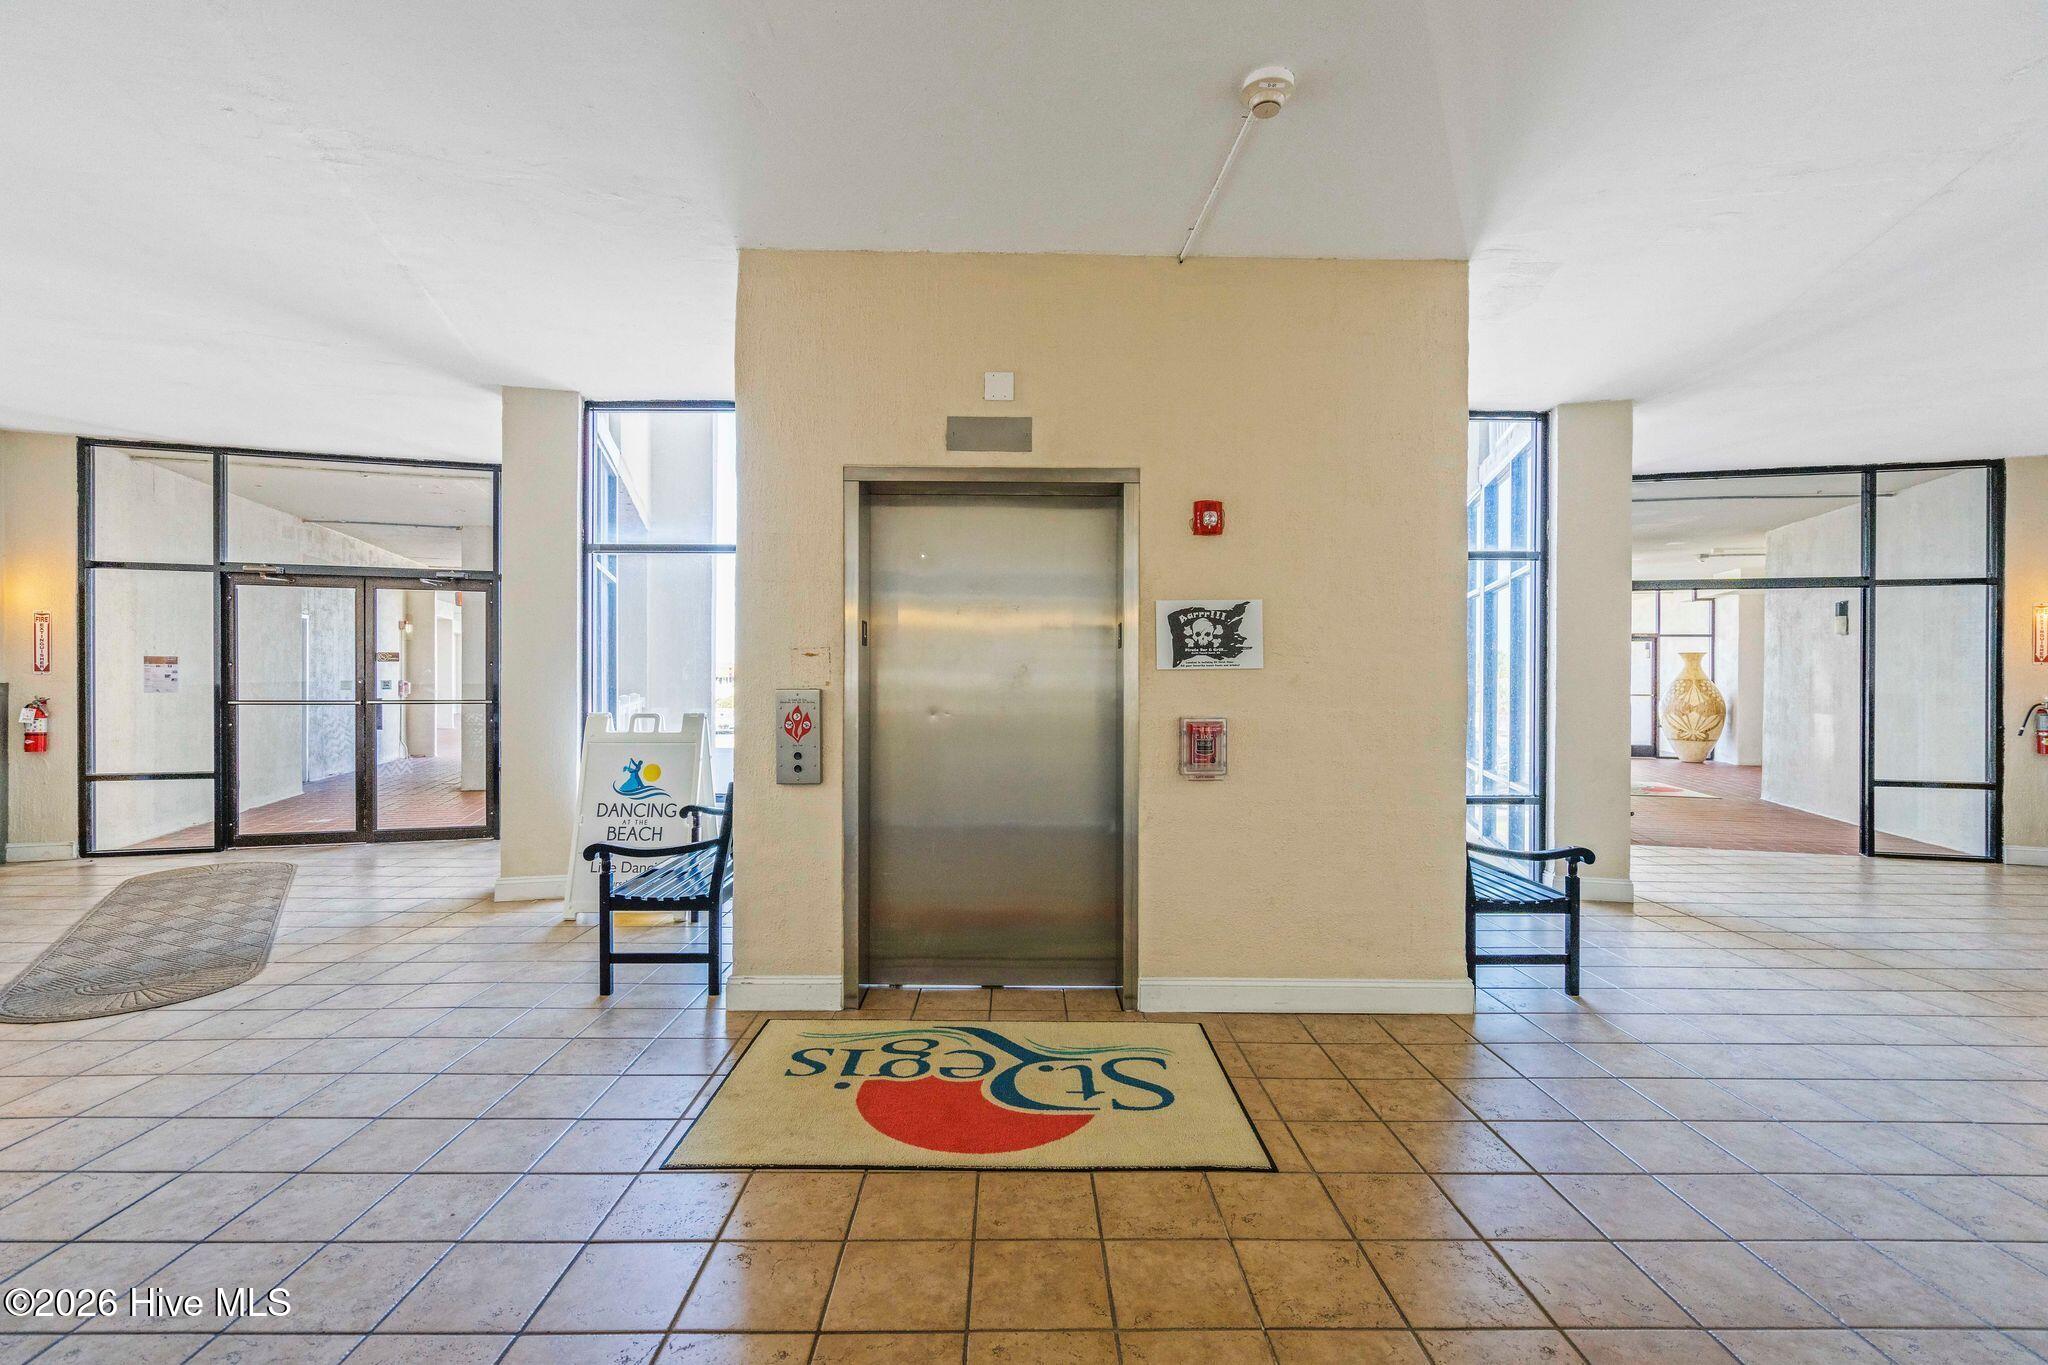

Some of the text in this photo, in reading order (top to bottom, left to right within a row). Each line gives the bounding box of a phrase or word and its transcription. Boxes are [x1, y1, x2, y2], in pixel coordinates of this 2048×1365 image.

[596, 802, 678, 818] DANCING
[606, 826, 663, 842] BEACH
[590, 861, 617, 873] Lie
[785, 1026, 1175, 1111] St. Regis
